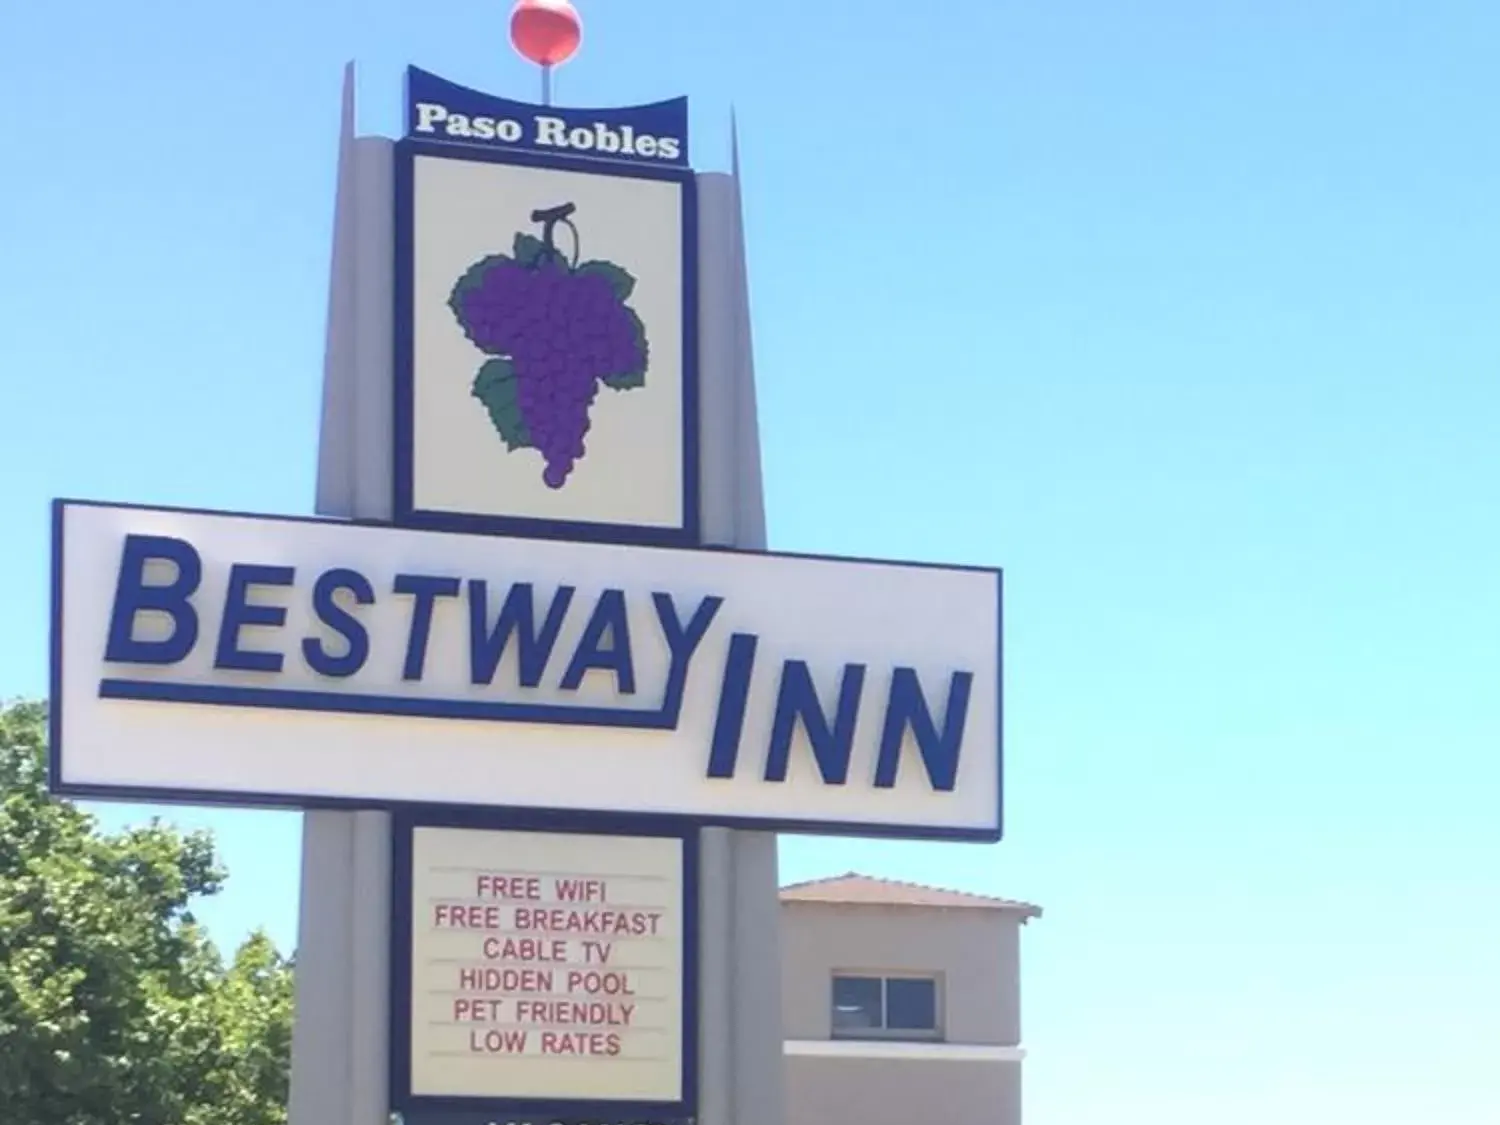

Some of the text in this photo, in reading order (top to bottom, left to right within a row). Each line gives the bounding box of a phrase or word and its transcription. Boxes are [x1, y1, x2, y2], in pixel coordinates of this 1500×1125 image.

[415, 103, 681, 160] Paso Robles
[100, 534, 975, 792] BESTWAY INN
[476, 876, 607, 903] FREE WIFI
[434, 905, 662, 935] FREE BREAKFAST
[483, 938, 612, 963] CABLE TV
[459, 969, 635, 995] HIDDEN POOL
[454, 999, 636, 1025] PET FRIENDLY
[470, 1030, 622, 1056] LOW RATES
